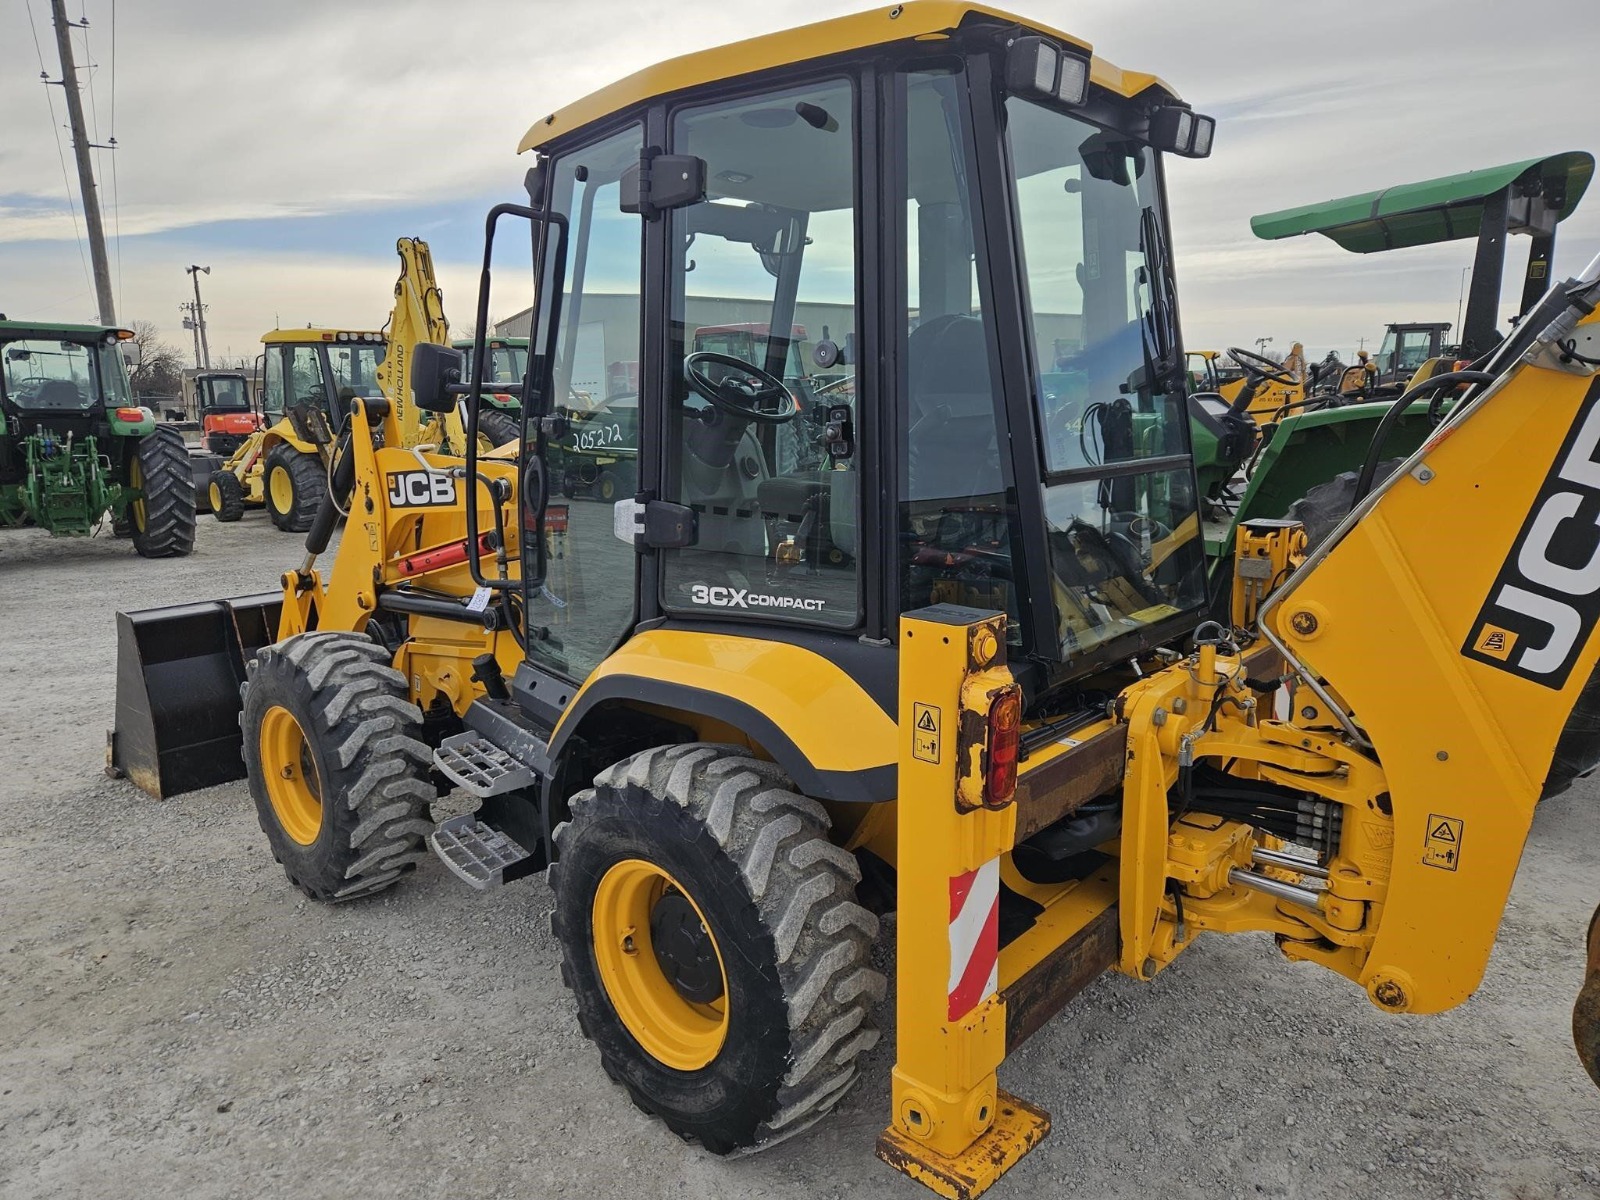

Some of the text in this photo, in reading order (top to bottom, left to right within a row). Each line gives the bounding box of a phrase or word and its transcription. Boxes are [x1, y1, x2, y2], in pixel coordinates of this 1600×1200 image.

[396, 345, 404, 421] NEW HOLLAND
[573, 423, 623, 453] 205272
[389, 472, 456, 506] JCB
[691, 584, 825, 611] 3CX COMPACT
[1484, 633, 1504, 650] JCB
